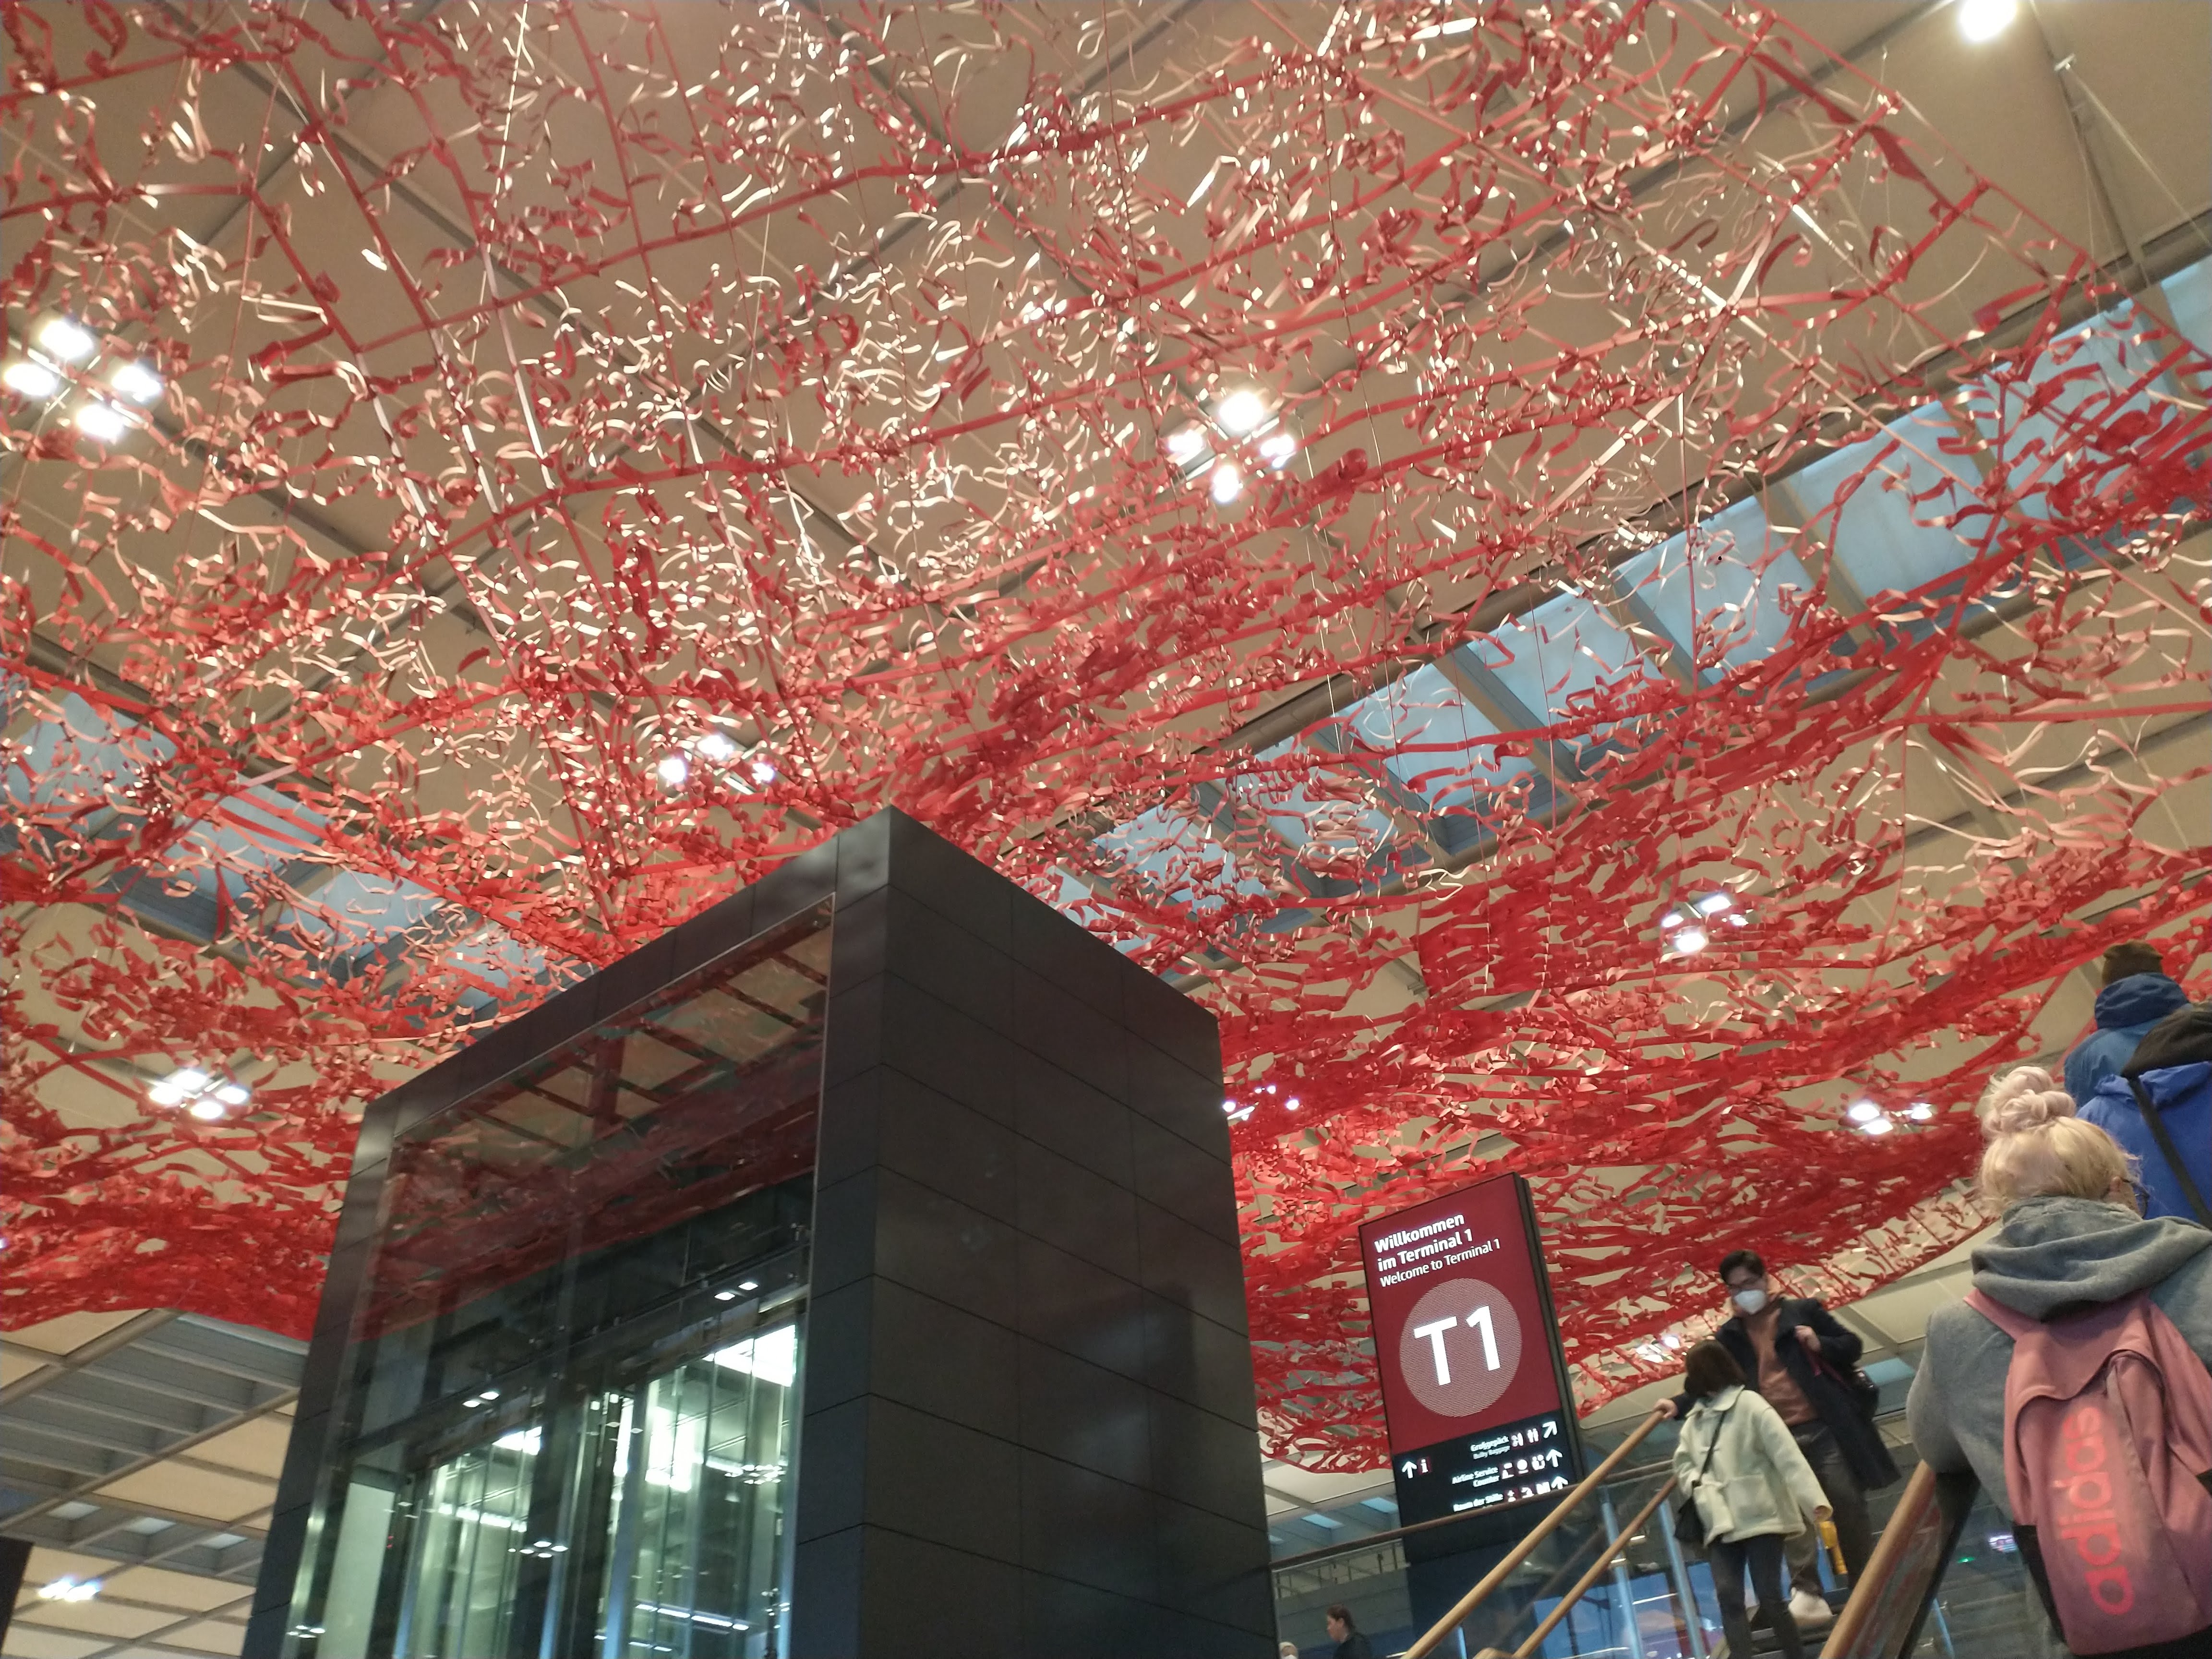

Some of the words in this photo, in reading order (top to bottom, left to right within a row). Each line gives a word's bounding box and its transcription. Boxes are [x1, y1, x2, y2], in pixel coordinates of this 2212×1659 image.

[1374, 1214, 1465, 1253] Willkommen
[1377, 1258, 1397, 1272] im
[1397, 1231, 1463, 1264] Terminal
[1464, 1228, 1473, 1241] 1
[1380, 1264, 1430, 1287] Welcome
[1431, 1260, 1443, 1271] to
[1443, 1240, 1493, 1265] Terminal
[1493, 1238, 1500, 1249] 1
[1413, 1306, 1501, 1386] T1
[1474, 1467, 1499, 1479] Service
[2053, 1407, 2135, 1616] adidas
